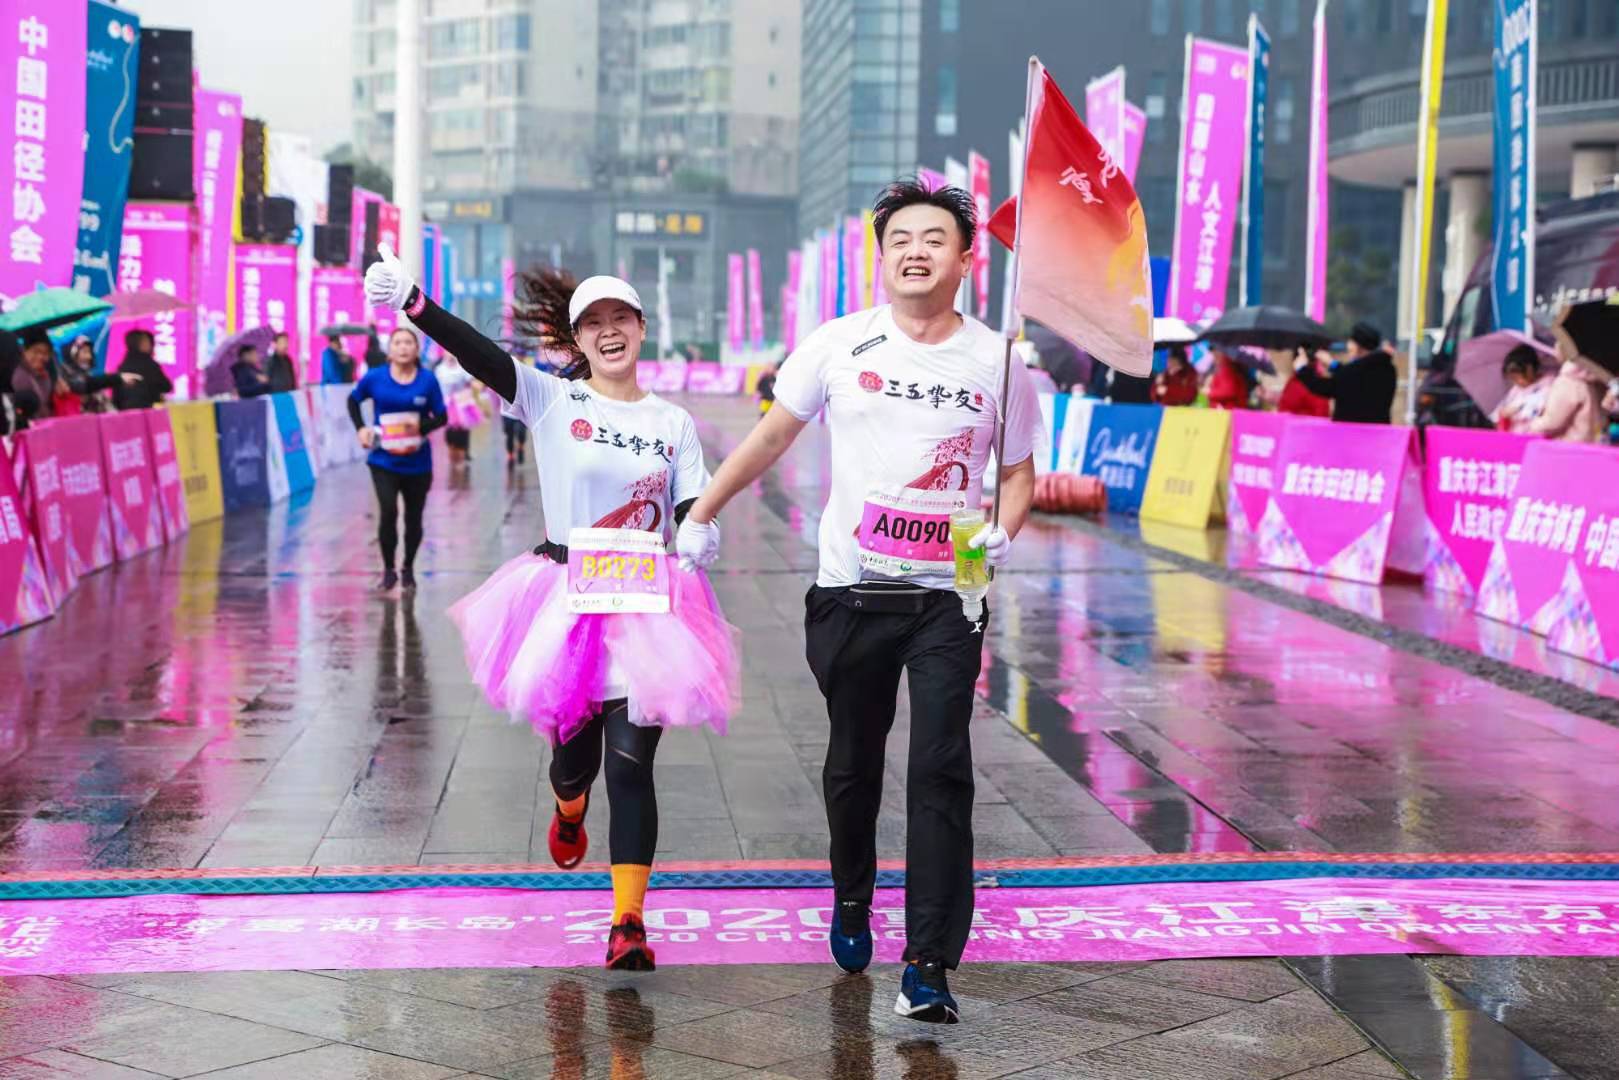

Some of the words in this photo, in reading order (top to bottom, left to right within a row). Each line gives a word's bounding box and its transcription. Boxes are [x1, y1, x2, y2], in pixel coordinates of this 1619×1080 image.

[10, 15, 48, 265] 中国田径协会
[883, 379, 982, 413] 三五挚友
[872, 512, 950, 544] A0090
[581, 554, 656, 581] B0273
[1080, 922, 1347, 940] JIANGJIN
[1359, 922, 1619, 935] ORIENTA
